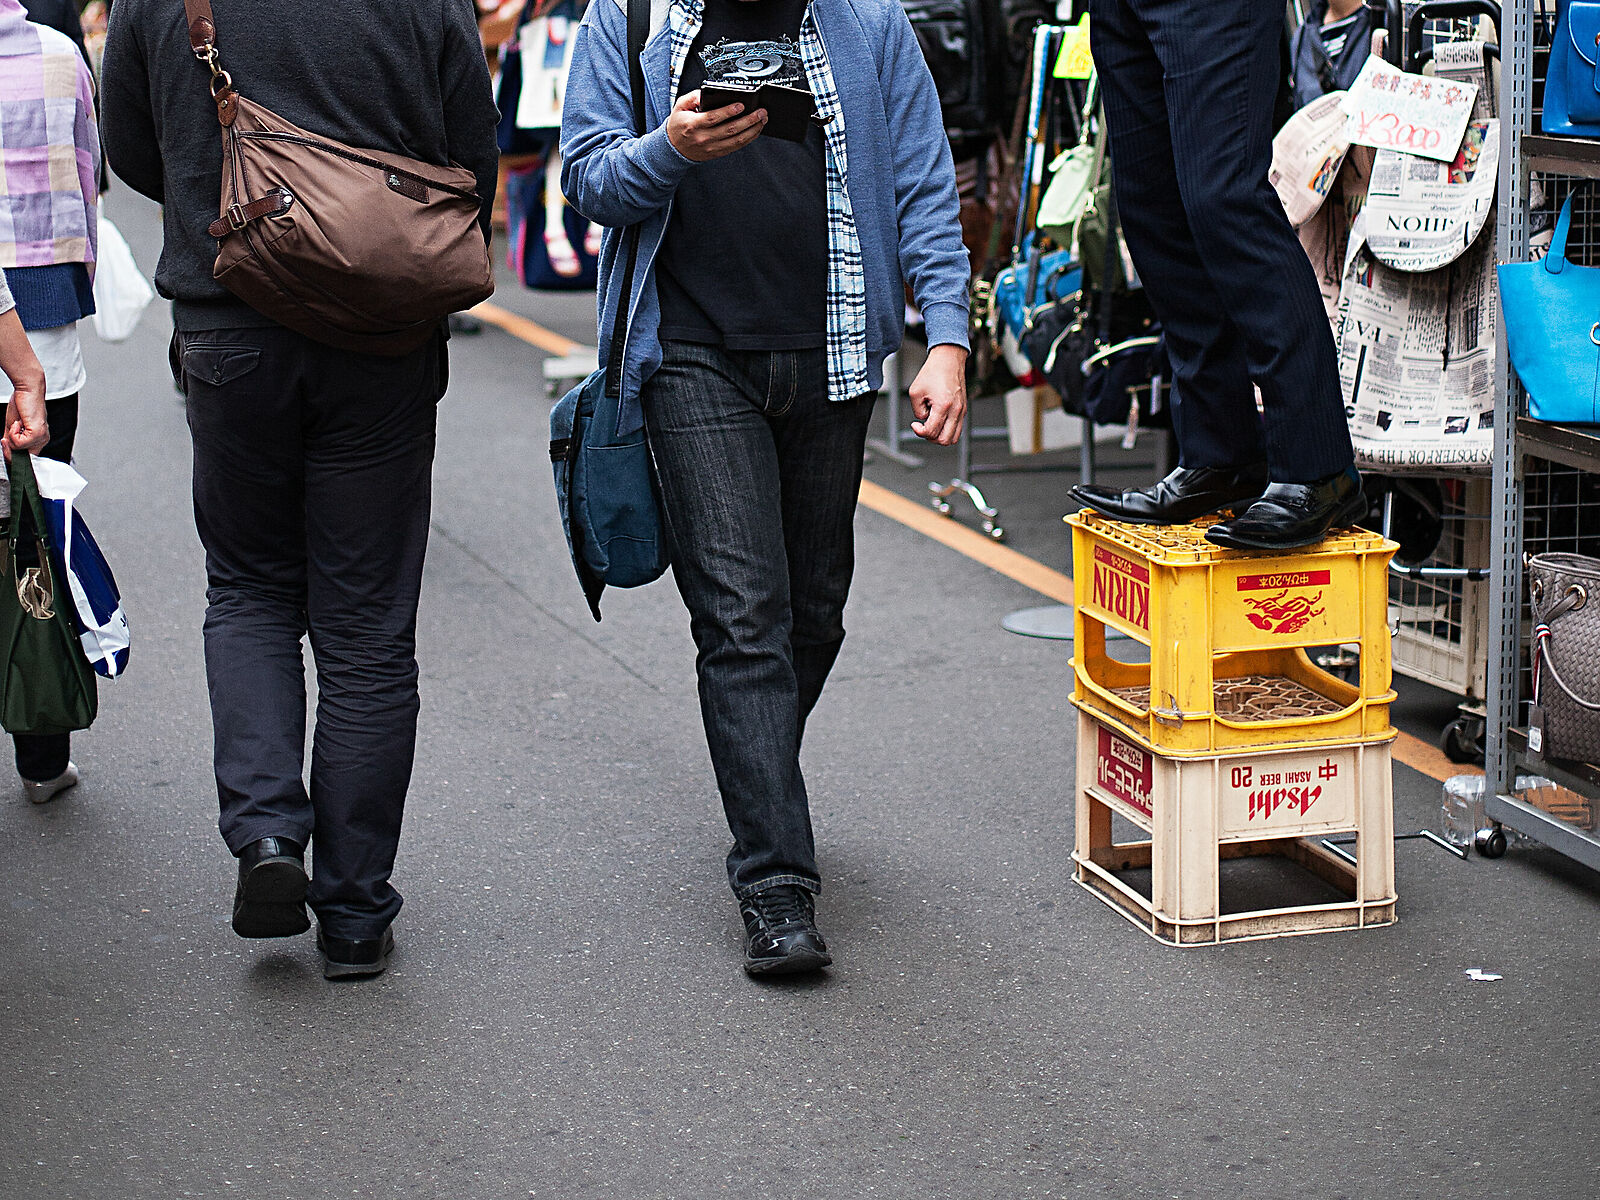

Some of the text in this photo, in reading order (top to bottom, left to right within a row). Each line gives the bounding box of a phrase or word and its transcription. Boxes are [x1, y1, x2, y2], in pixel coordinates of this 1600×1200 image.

[1379, 449, 1406, 465] THE
[1409, 449, 1433, 464] FOR
[1432, 449, 1479, 465] POSTER
[1259, 573, 1309, 588] 中びん20本
[1093, 562, 1150, 630] KIRIN
[1231, 758, 1338, 788] 中 ASAHI BEER 20
[1248, 785, 1322, 822] Asahi
